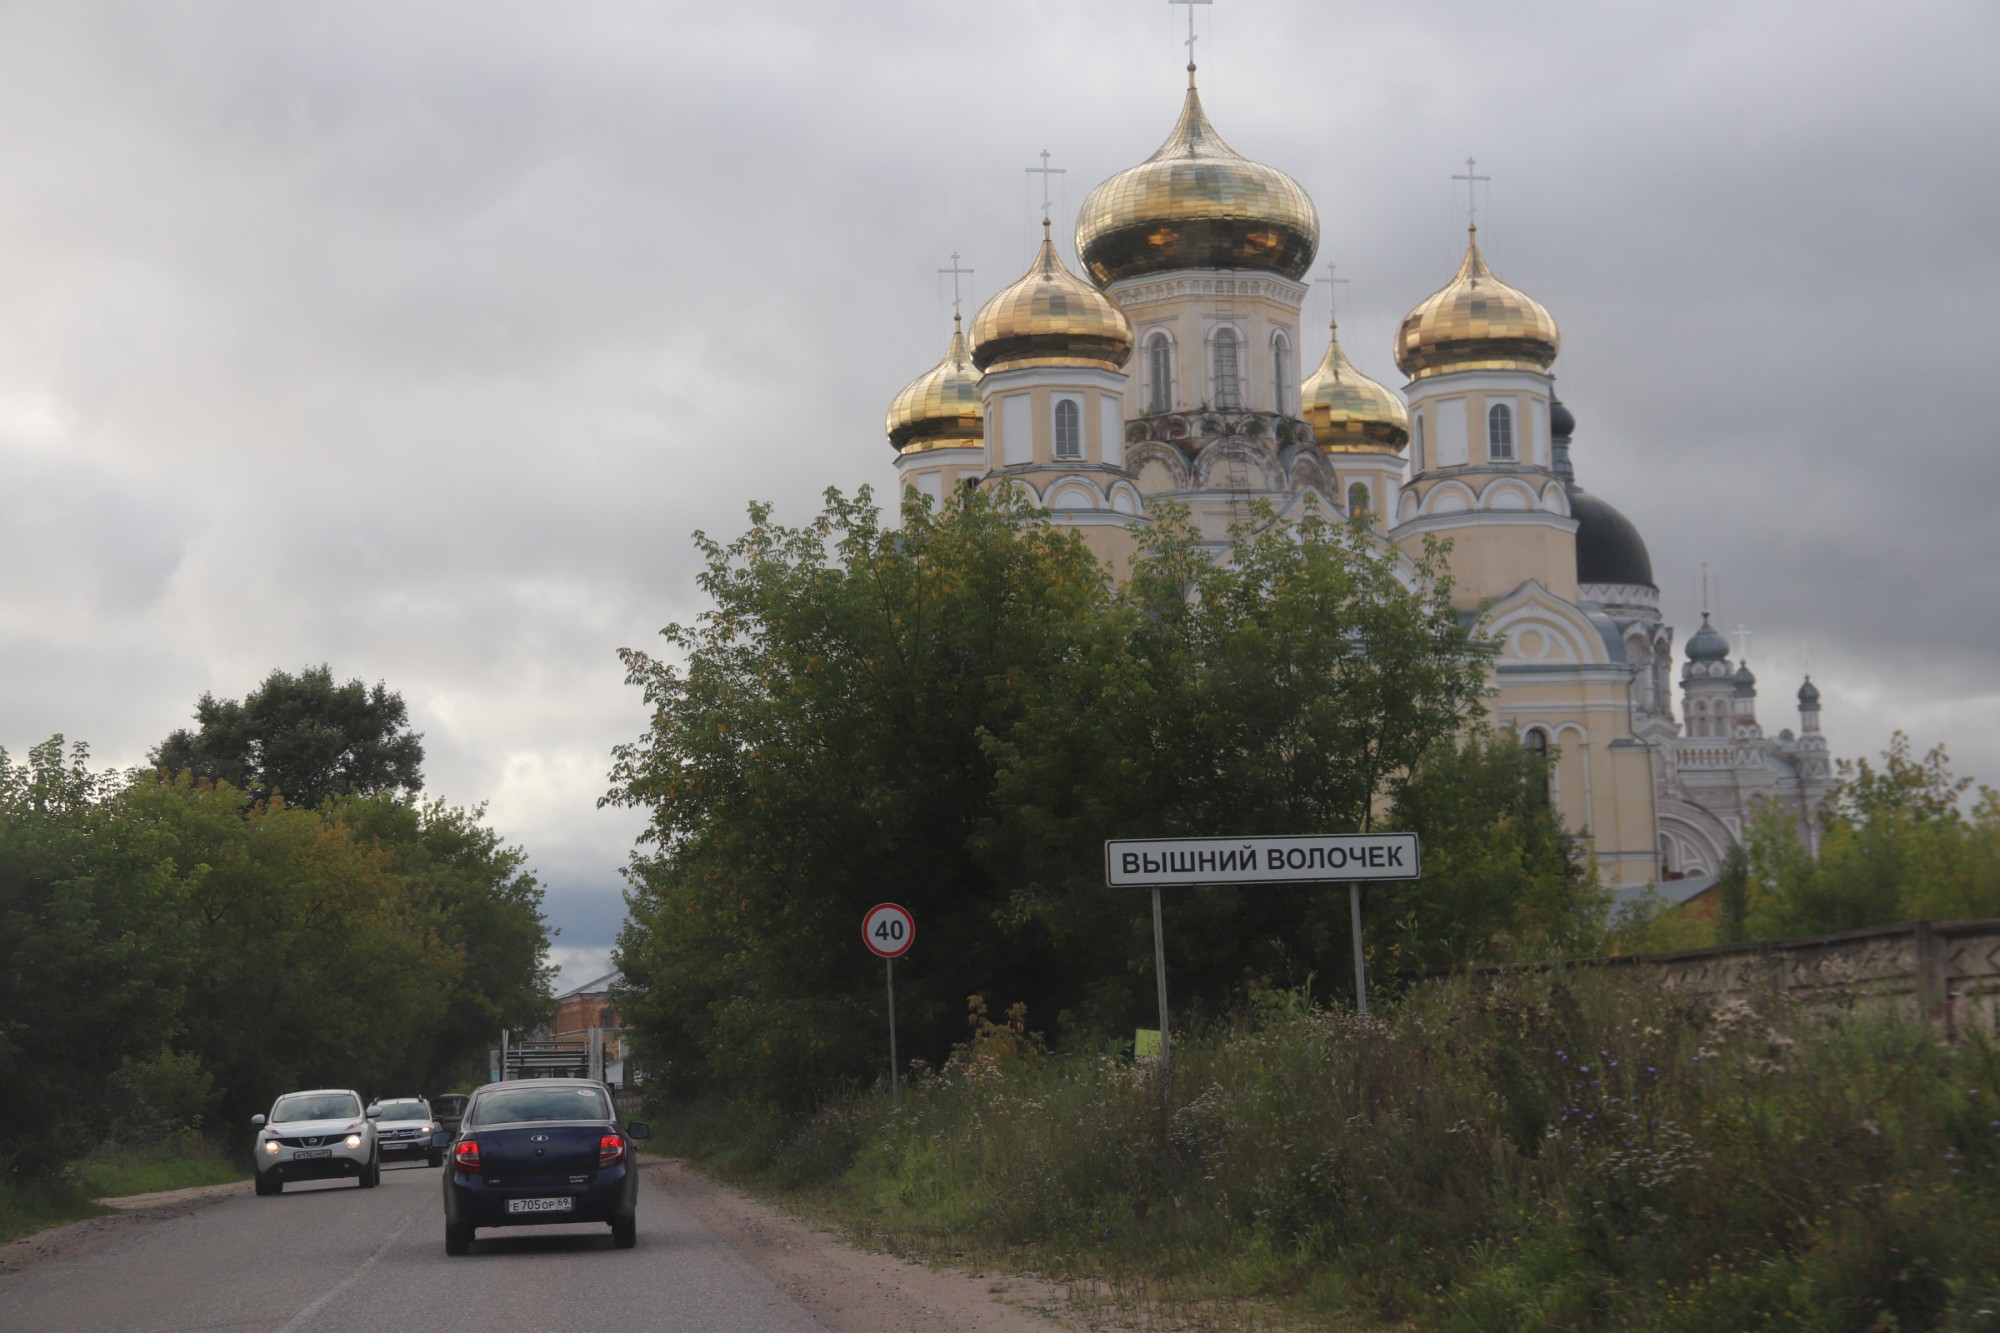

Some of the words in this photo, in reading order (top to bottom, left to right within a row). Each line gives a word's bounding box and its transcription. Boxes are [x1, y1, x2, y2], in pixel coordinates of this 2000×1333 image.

[1121, 845, 1258, 874] ВЫШНИЙ
[1267, 845, 1404, 871] ВОЛОЧЕК
[874, 920, 904, 940] 40
